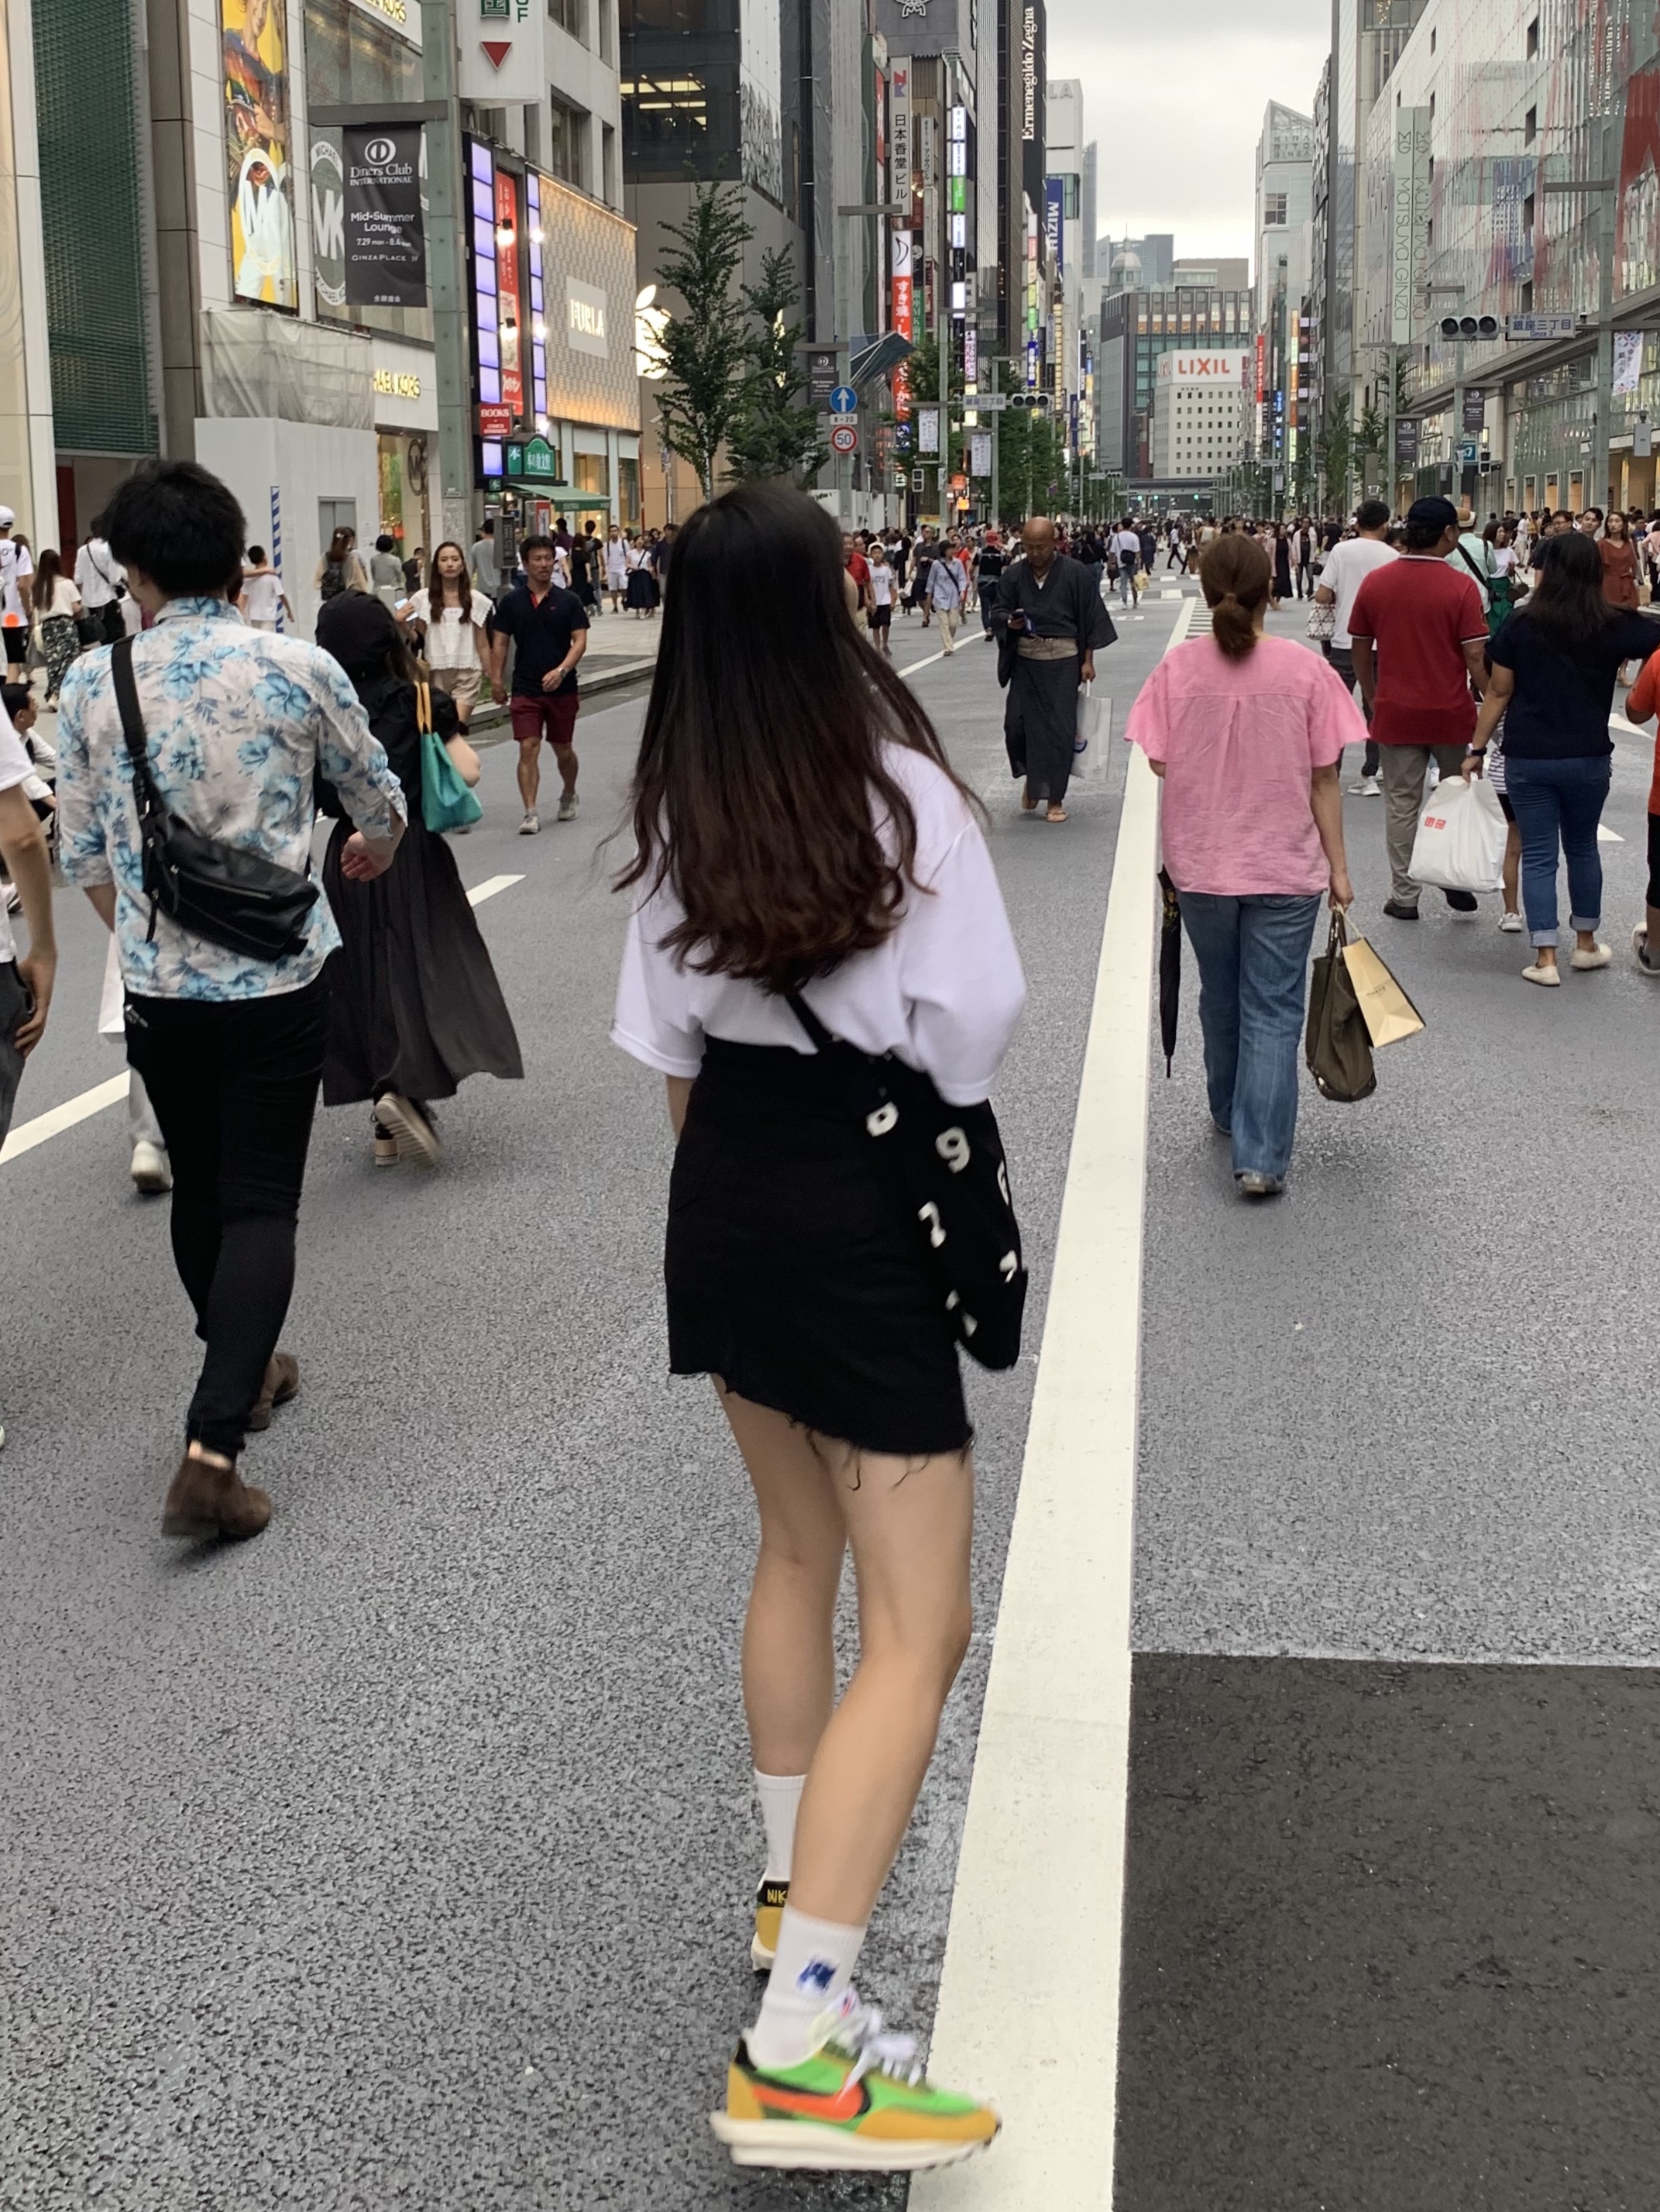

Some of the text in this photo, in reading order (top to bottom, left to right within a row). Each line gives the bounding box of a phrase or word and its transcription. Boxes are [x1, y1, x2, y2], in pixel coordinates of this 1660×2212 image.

[1022, 6, 1037, 141] Ermenegildo Zegna
[895, 115, 907, 200] 日本香堂ビル
[350, 163, 413, 178] Diners Club
[350, 211, 415, 222] Mid-Summer
[364, 222, 403, 234] Lounge
[570, 299, 604, 338] FURLA
[1513, 318, 1572, 331] 銀座三丁目
[1178, 357, 1230, 376] LIXIL
[480, 408, 510, 418] BOOKS
[837, 433, 852, 445] 50
[508, 447, 522, 461] 本
[767, 1888, 787, 1904] NIK
